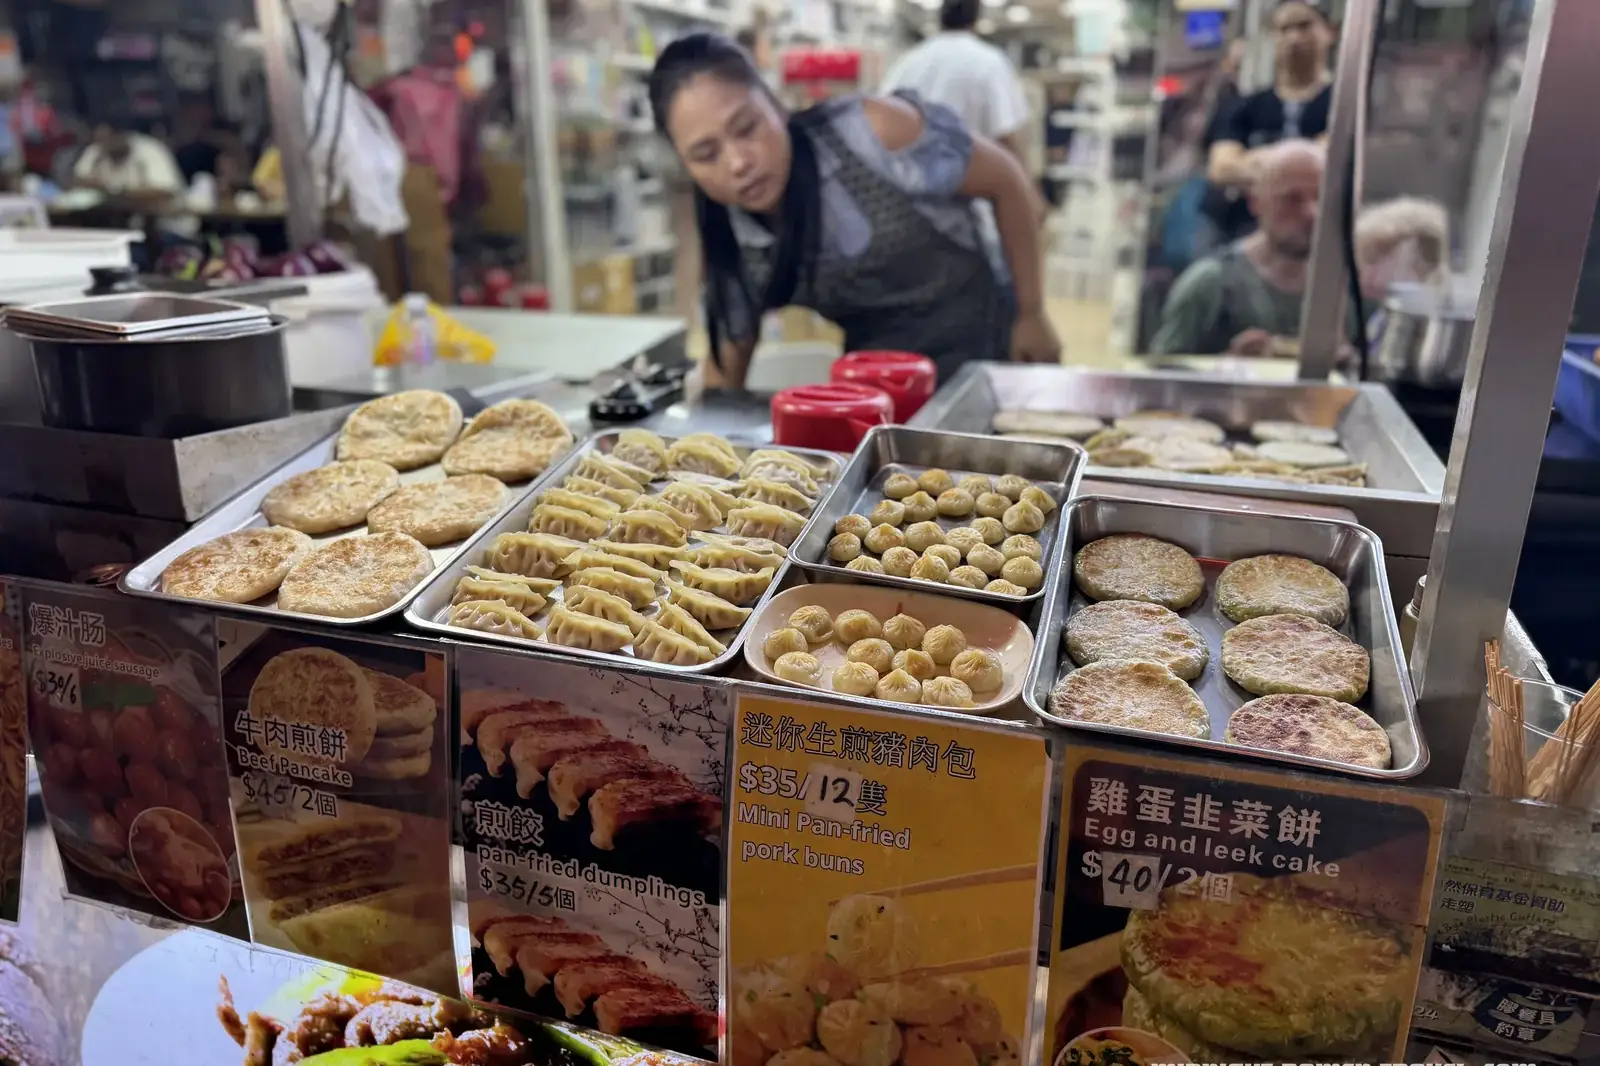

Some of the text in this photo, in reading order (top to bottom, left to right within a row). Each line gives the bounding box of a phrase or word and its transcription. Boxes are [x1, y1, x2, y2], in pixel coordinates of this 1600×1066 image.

[29, 602, 106, 646] 爆汁肠
[32, 644, 159, 679] Explosive juice sausage
[235, 711, 347, 762] 牛肉煎餅
[740, 711, 976, 780] 迷你生煎豬肉包
[239, 749, 353, 787] Beef Pancake
[475, 802, 543, 845] 煎餃
[738, 803, 911, 850] Mini Pan-fried
[1086, 776, 1322, 849] 雞蛋韭菜餅
[742, 839, 865, 875] pork buns
[1084, 818, 1341, 878] Egg and leek cake
[478, 845, 706, 908] pan-fried dumplings
